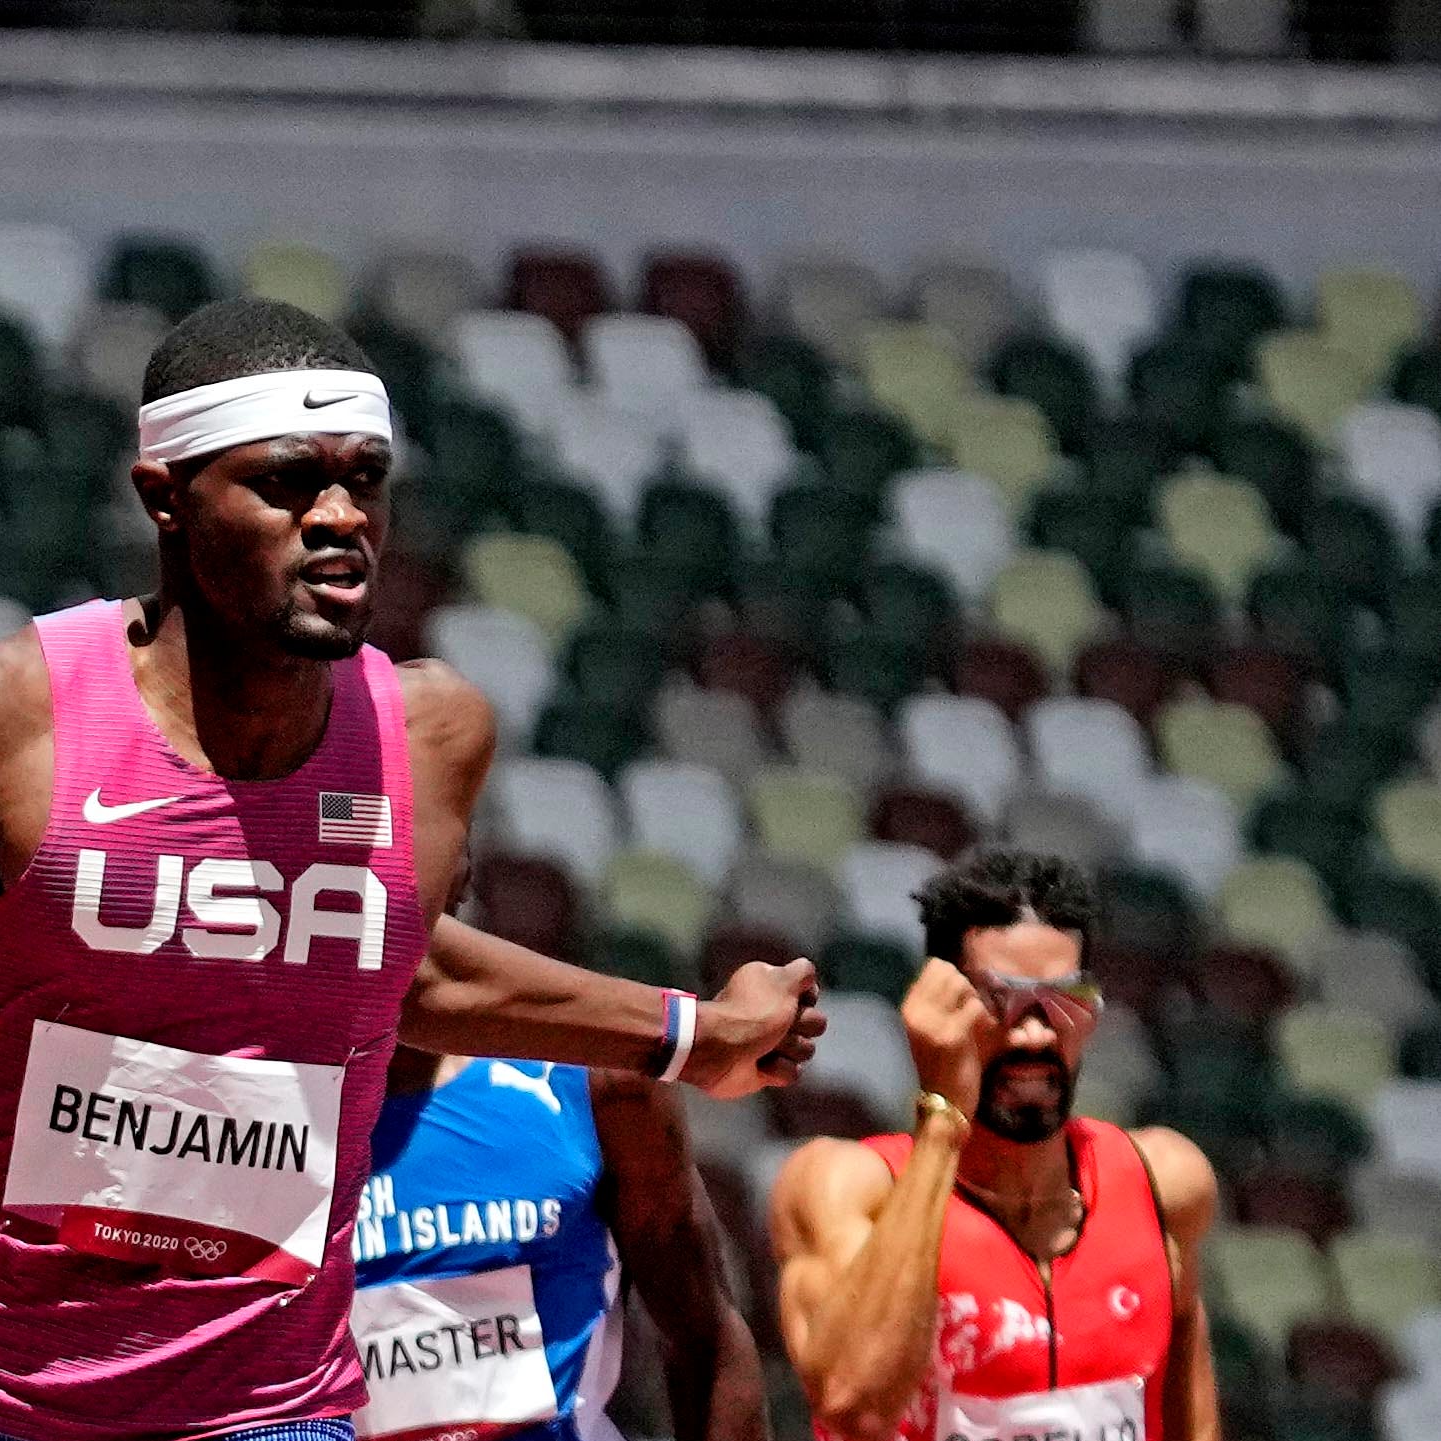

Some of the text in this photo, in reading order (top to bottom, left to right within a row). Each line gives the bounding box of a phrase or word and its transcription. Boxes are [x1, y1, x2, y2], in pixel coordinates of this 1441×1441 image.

[71, 848, 388, 970] USA
[49, 1083, 310, 1173] BENJAMIN
[93, 1222, 180, 1251] TOKYO 2020
[397, 1197, 562, 1255] ISLANDS
